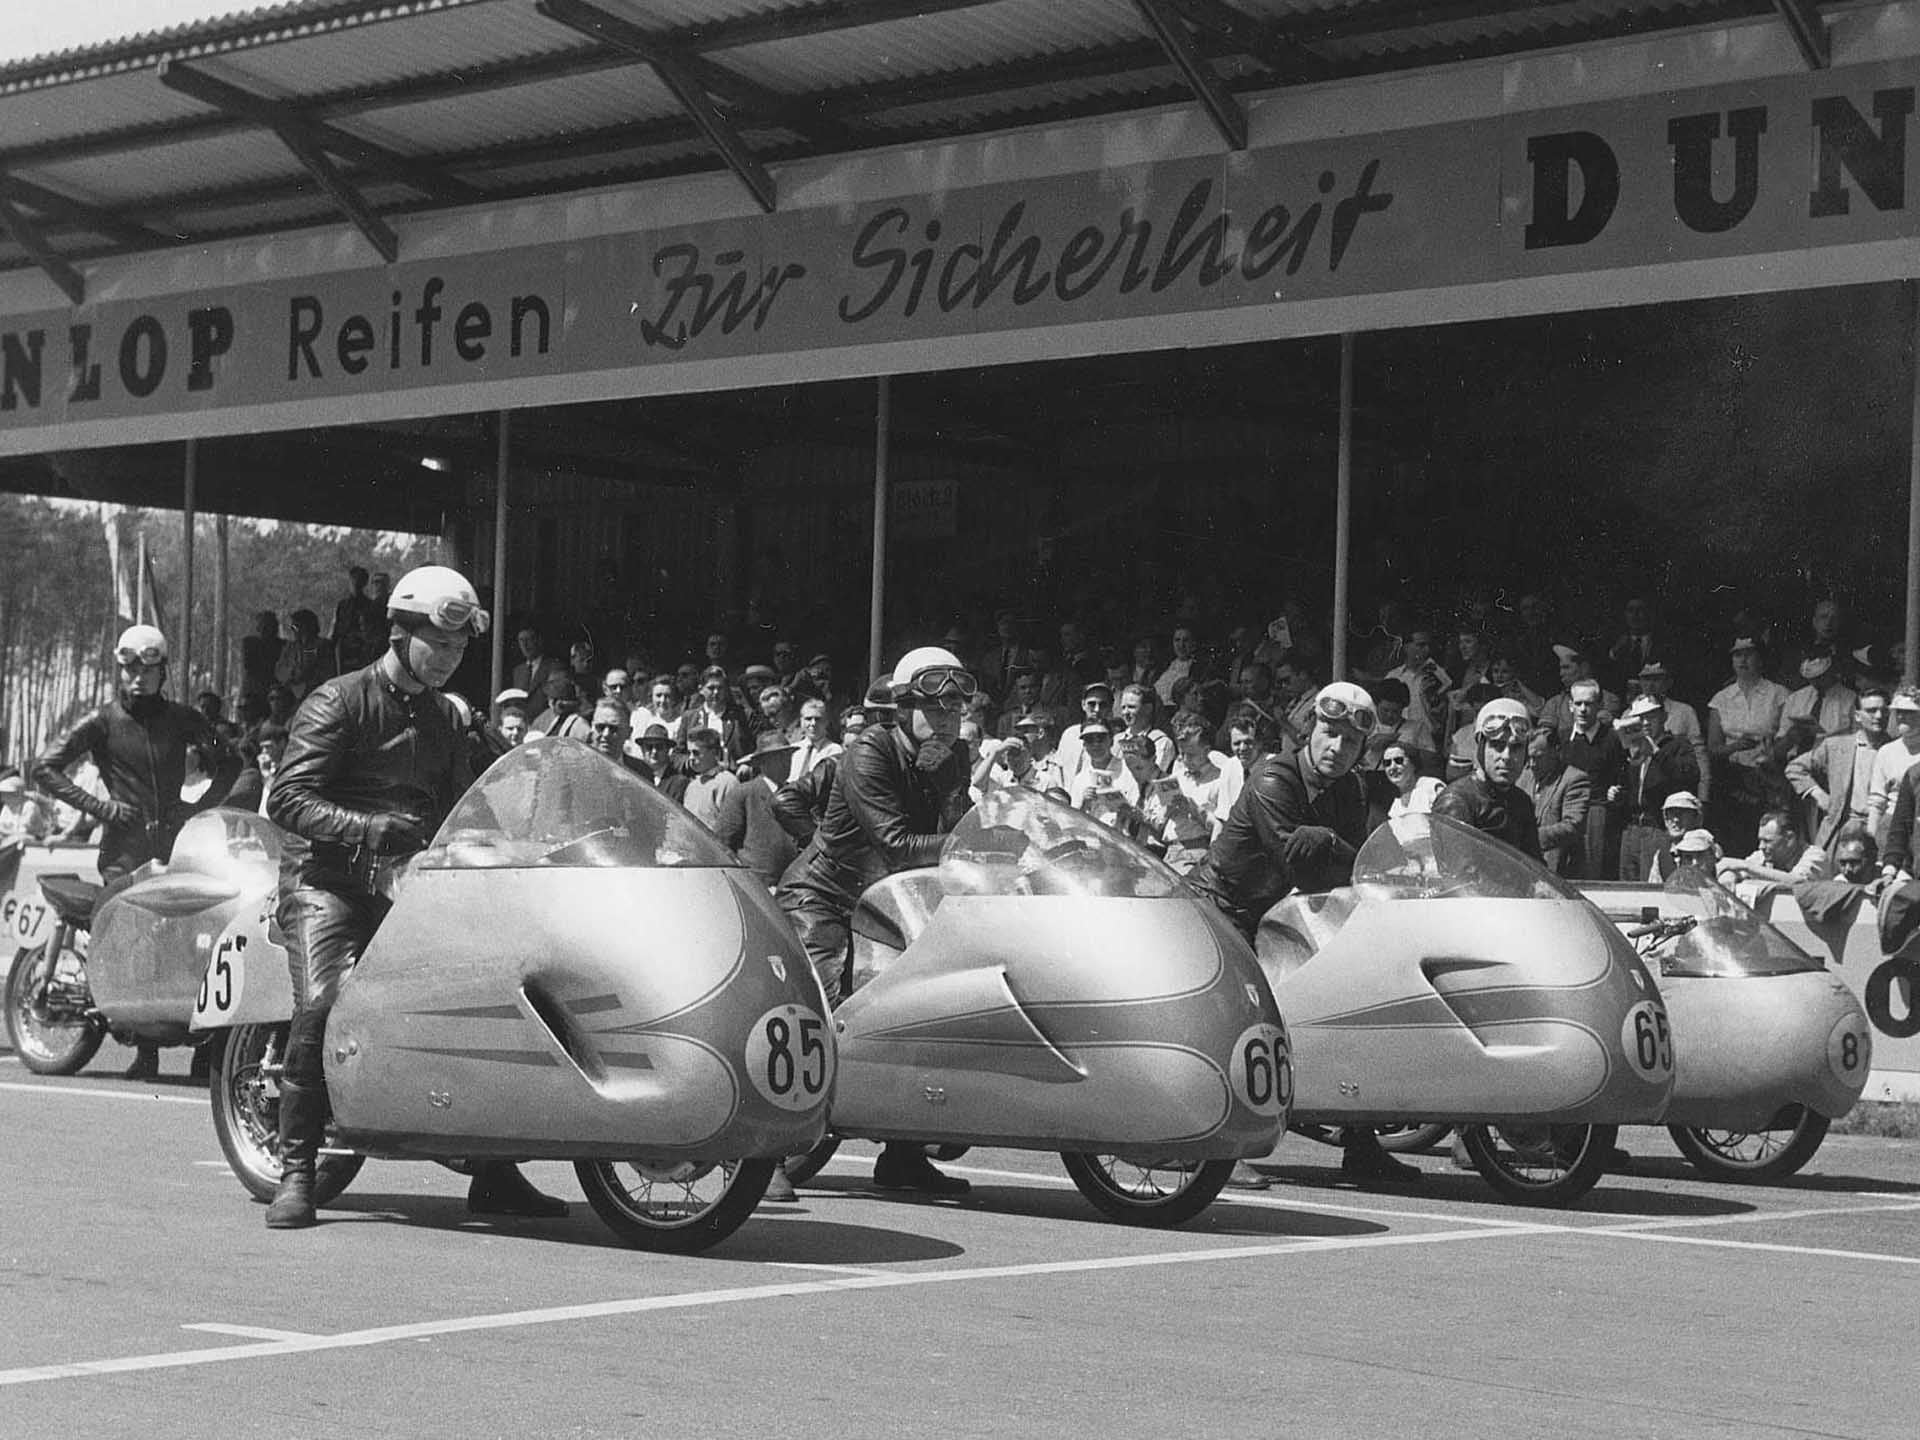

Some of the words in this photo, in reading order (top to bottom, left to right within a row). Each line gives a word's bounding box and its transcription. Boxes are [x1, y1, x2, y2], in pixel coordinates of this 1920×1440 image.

[0, 305, 235, 411] NLOP
[287, 275, 550, 381] Reifen
[838, 158, 1394, 324] Sicherheit
[1524, 86, 1917, 250] DUN
[18, 903, 47, 937] 67
[765, 1015, 826, 1097] 85
[1243, 1036, 1292, 1106] 66
[1634, 1010, 1672, 1073] 65
